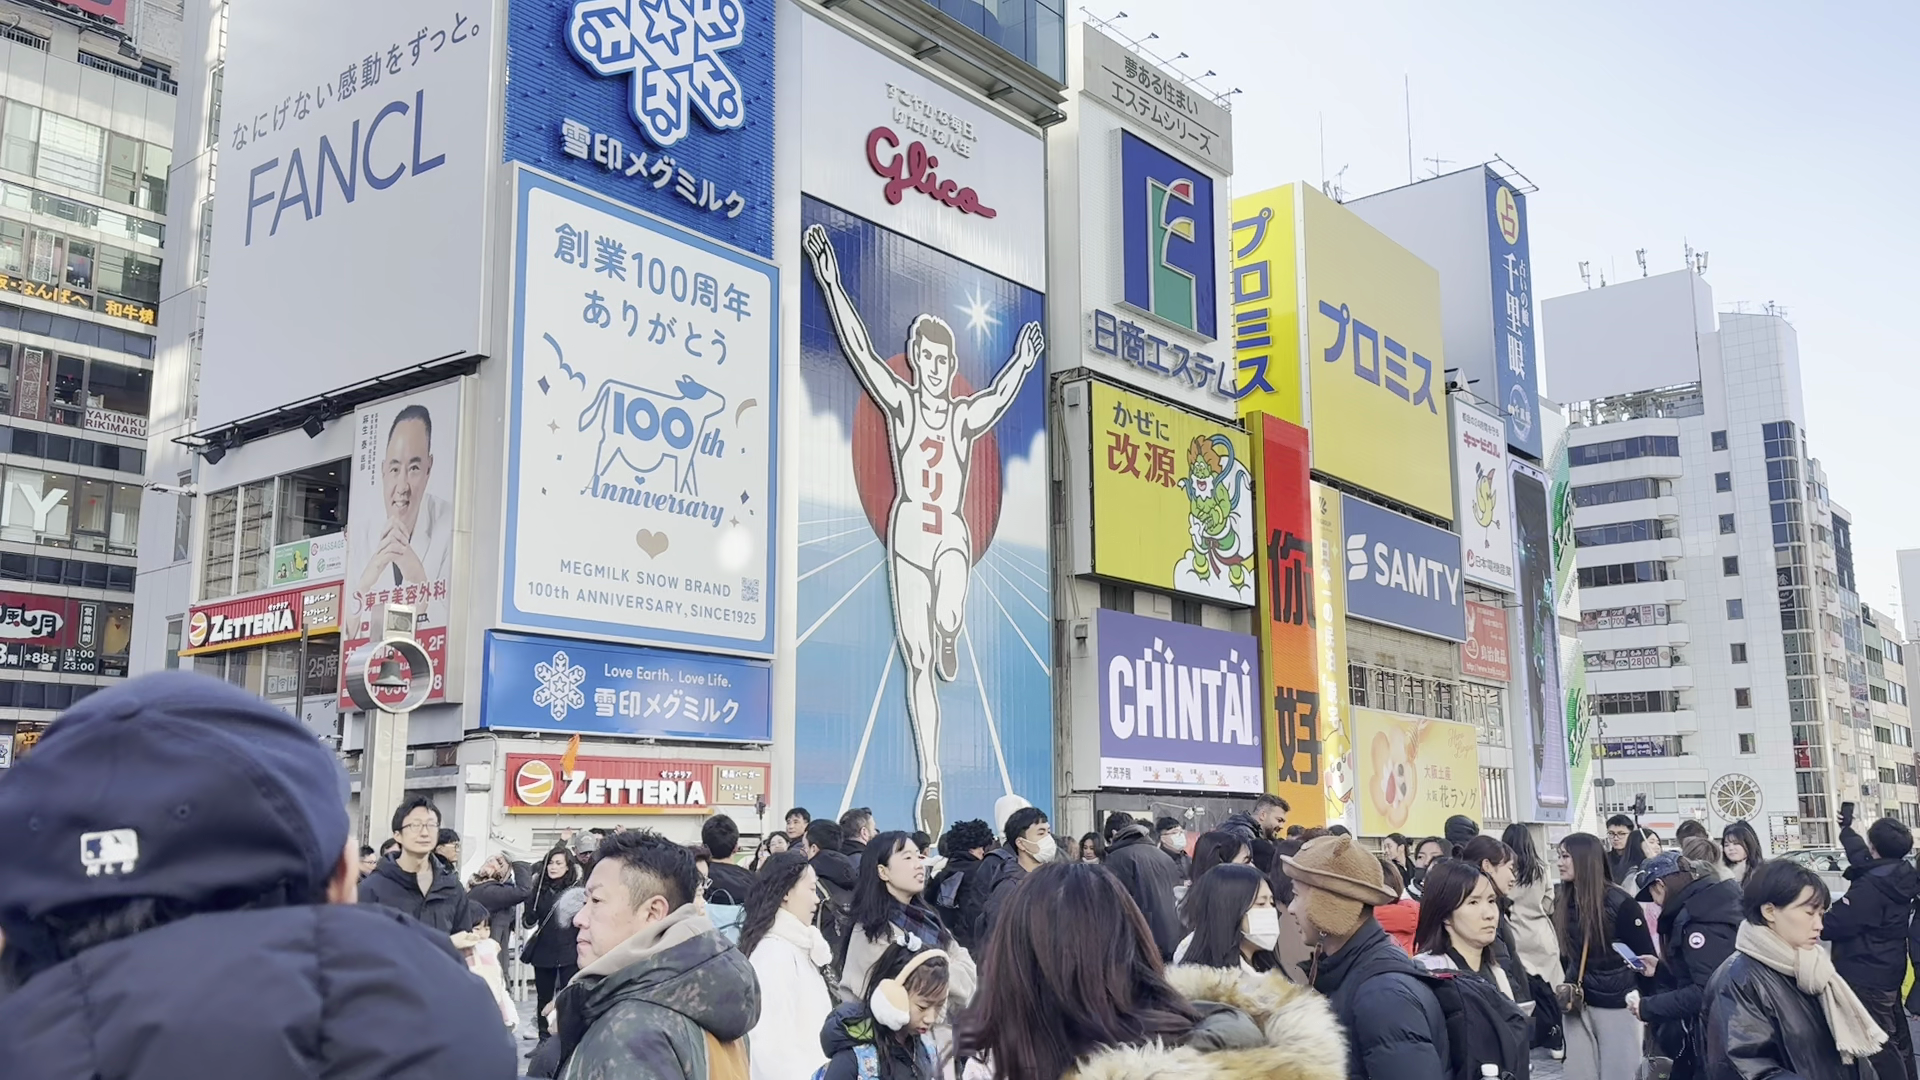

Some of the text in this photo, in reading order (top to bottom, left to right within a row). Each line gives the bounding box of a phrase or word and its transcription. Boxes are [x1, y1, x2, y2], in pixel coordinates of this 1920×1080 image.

[231, 12, 480, 150] なにげない感動をずっと。
[1124, 55, 1199, 115] 夢ある住まい
[1111, 81, 1211, 155] エステムシリーズ
[245, 89, 445, 246] FANCL
[561, 117, 745, 219] 雪印メグミルク
[867, 126, 997, 218] Glico
[554, 223, 751, 322] 創業100周年
[582, 290, 727, 365] ありがとう
[1231, 207, 1275, 399] プロミス
[1319, 300, 1438, 415] プロミス
[85, 418, 147, 437] RIKIMARU
[86, 409, 147, 428] YAKINIKU
[1112, 401, 1170, 441] かぜに
[919, 435, 946, 536] グリコ
[1106, 430, 1176, 488] 改源
[580, 474, 724, 528] Anniversary
[528, 582, 569, 600] 100th
[560, 559, 731, 597] MEGMILK SNOW BRAND
[1374, 542, 1460, 606] SAMTY
[208, 609, 295, 642] ZETTERIA
[428, 635, 445, 651] 2F
[63, 662, 94, 671] 23:00
[604, 663, 732, 688] Love Earth. Love Life.
[1109, 637, 1253, 746] CHINTAI
[594, 688, 739, 724] 雪印メグミルク
[560, 770, 706, 805] ZETTERIA
[1106, 766, 1131, 780] 天気予報
